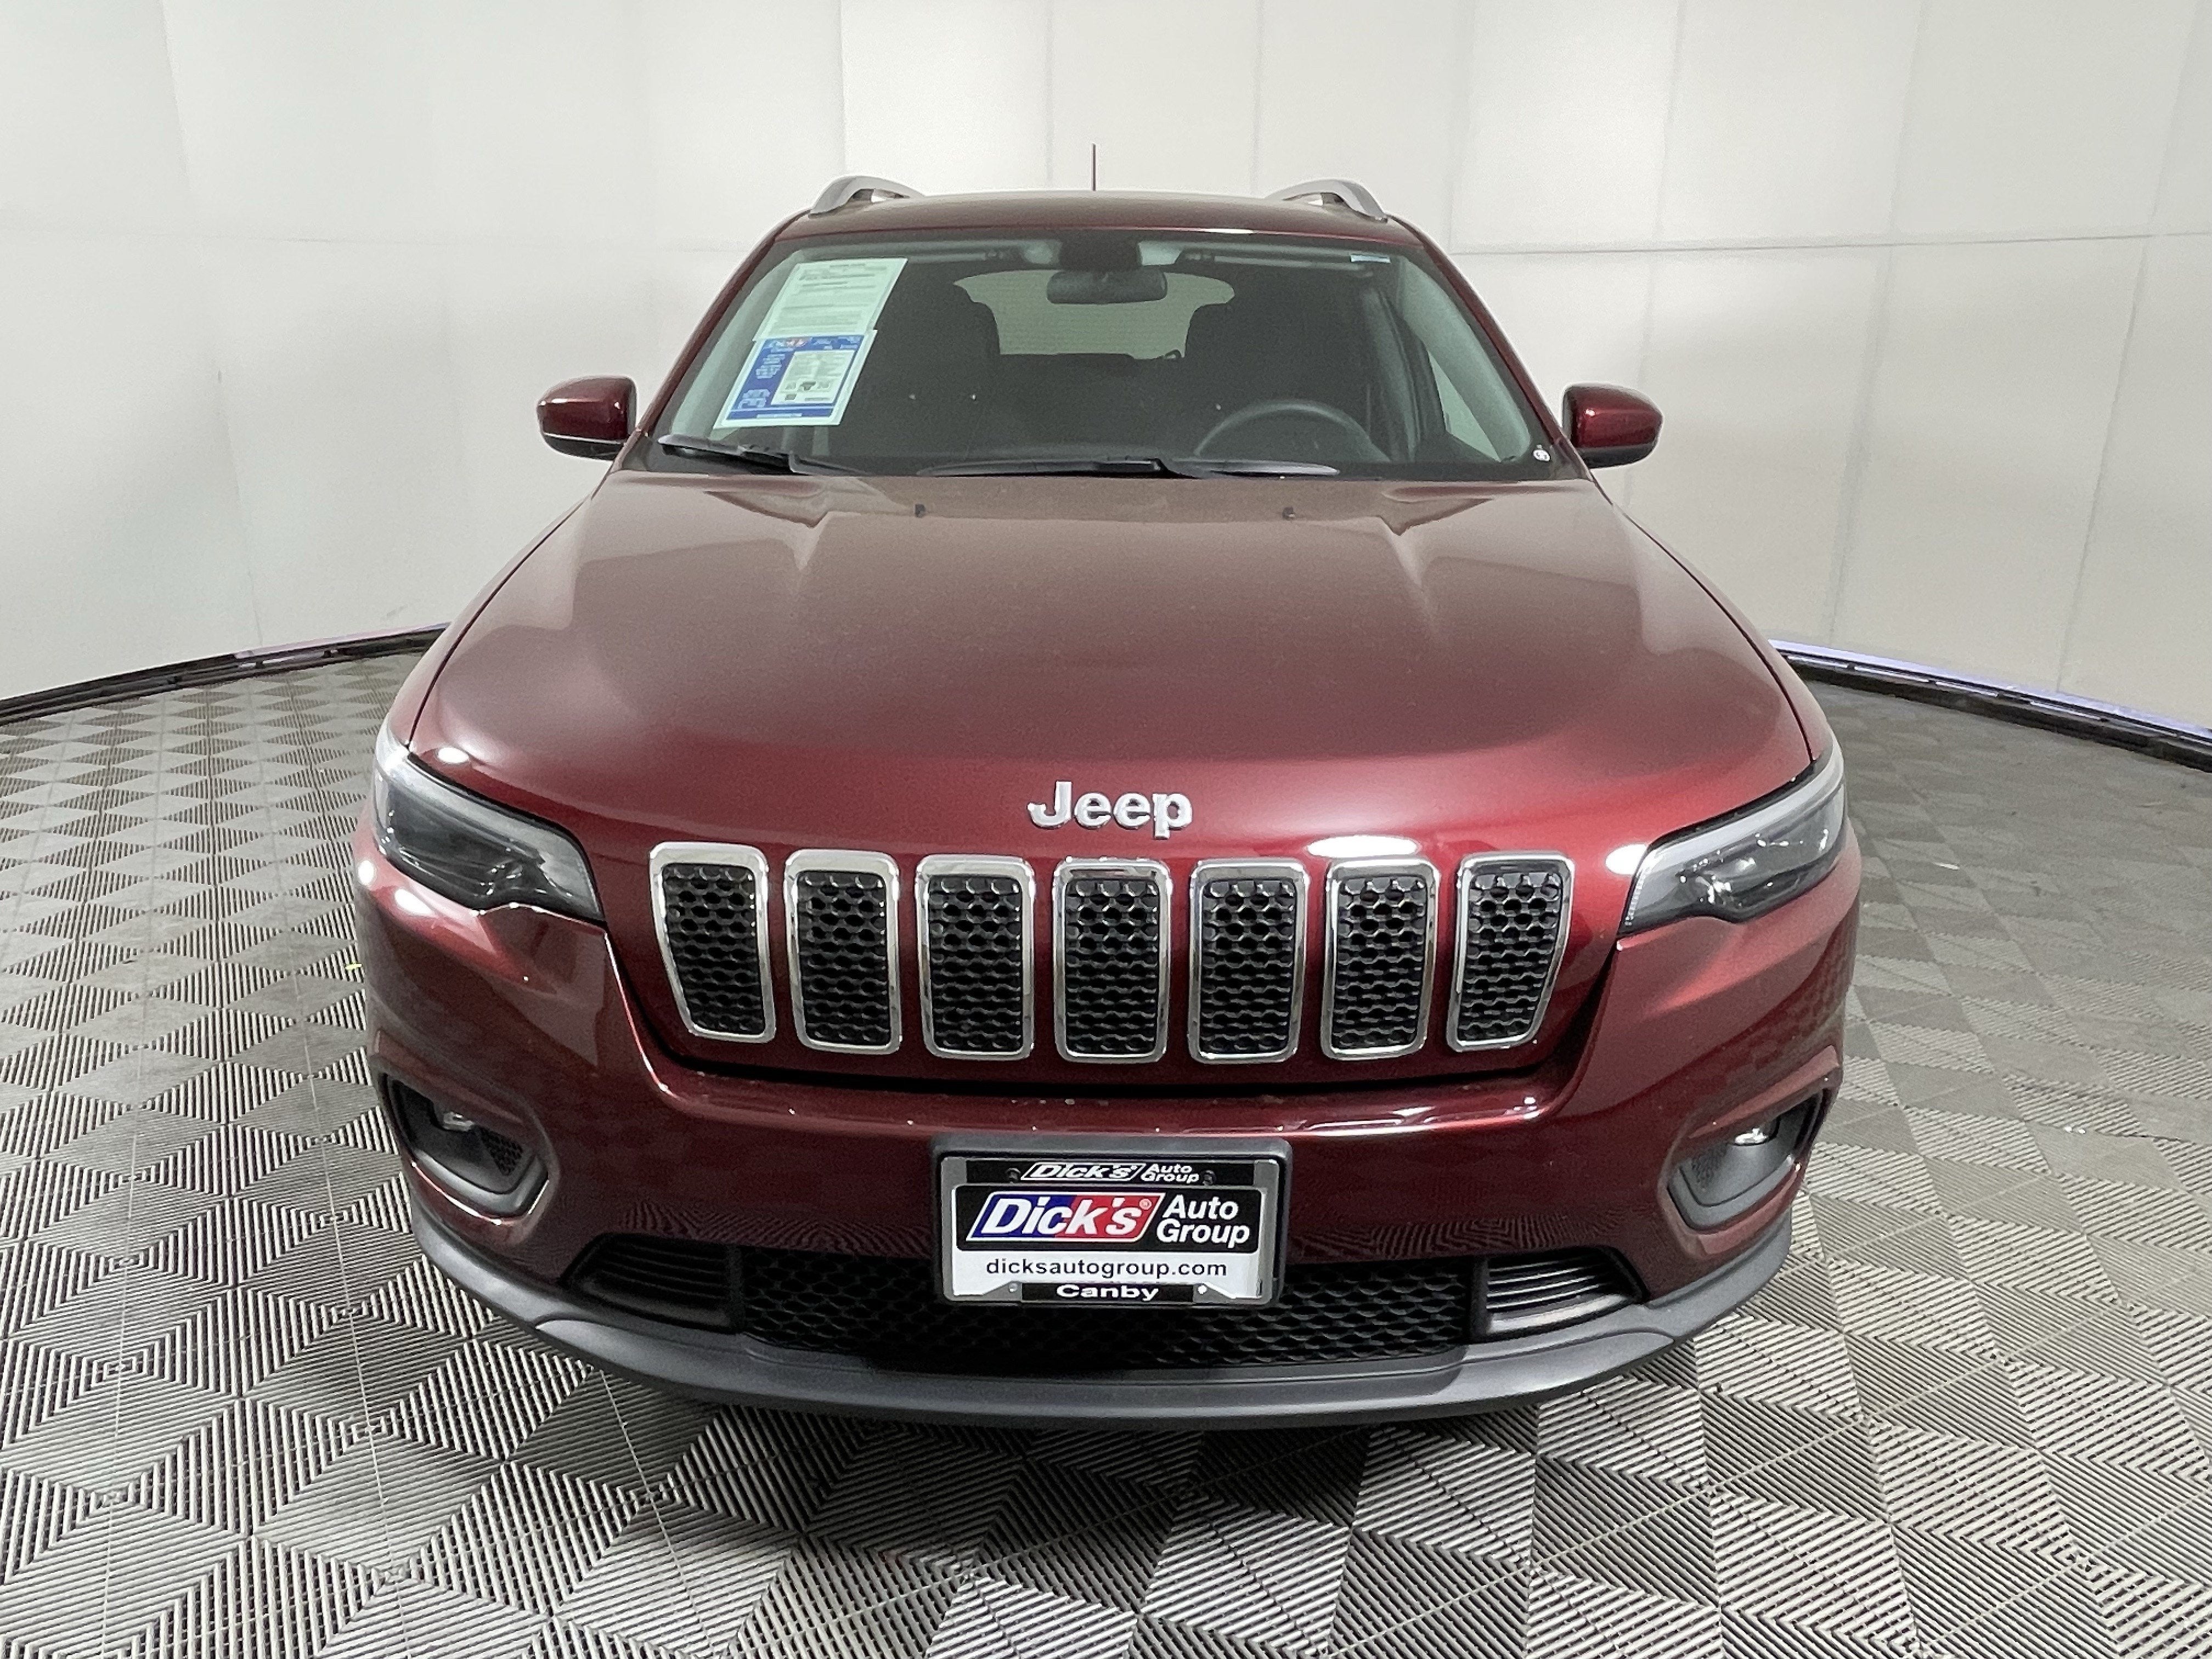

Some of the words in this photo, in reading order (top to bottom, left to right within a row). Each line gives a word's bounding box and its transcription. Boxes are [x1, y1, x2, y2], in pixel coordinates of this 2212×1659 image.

[1026, 780, 1193, 839] Jeep
[1029, 1163, 1133, 1178] Dick's
[1140, 1172, 1200, 1184] Group
[1149, 1163, 1193, 1173] Auto
[980, 1196, 1143, 1235] Dick's
[1162, 1194, 1239, 1220] Auto
[1156, 1218, 1250, 1248] Group
[986, 1258, 1227, 1279] dicksautogroup.com
[1056, 1284, 1159, 1302] Canby
